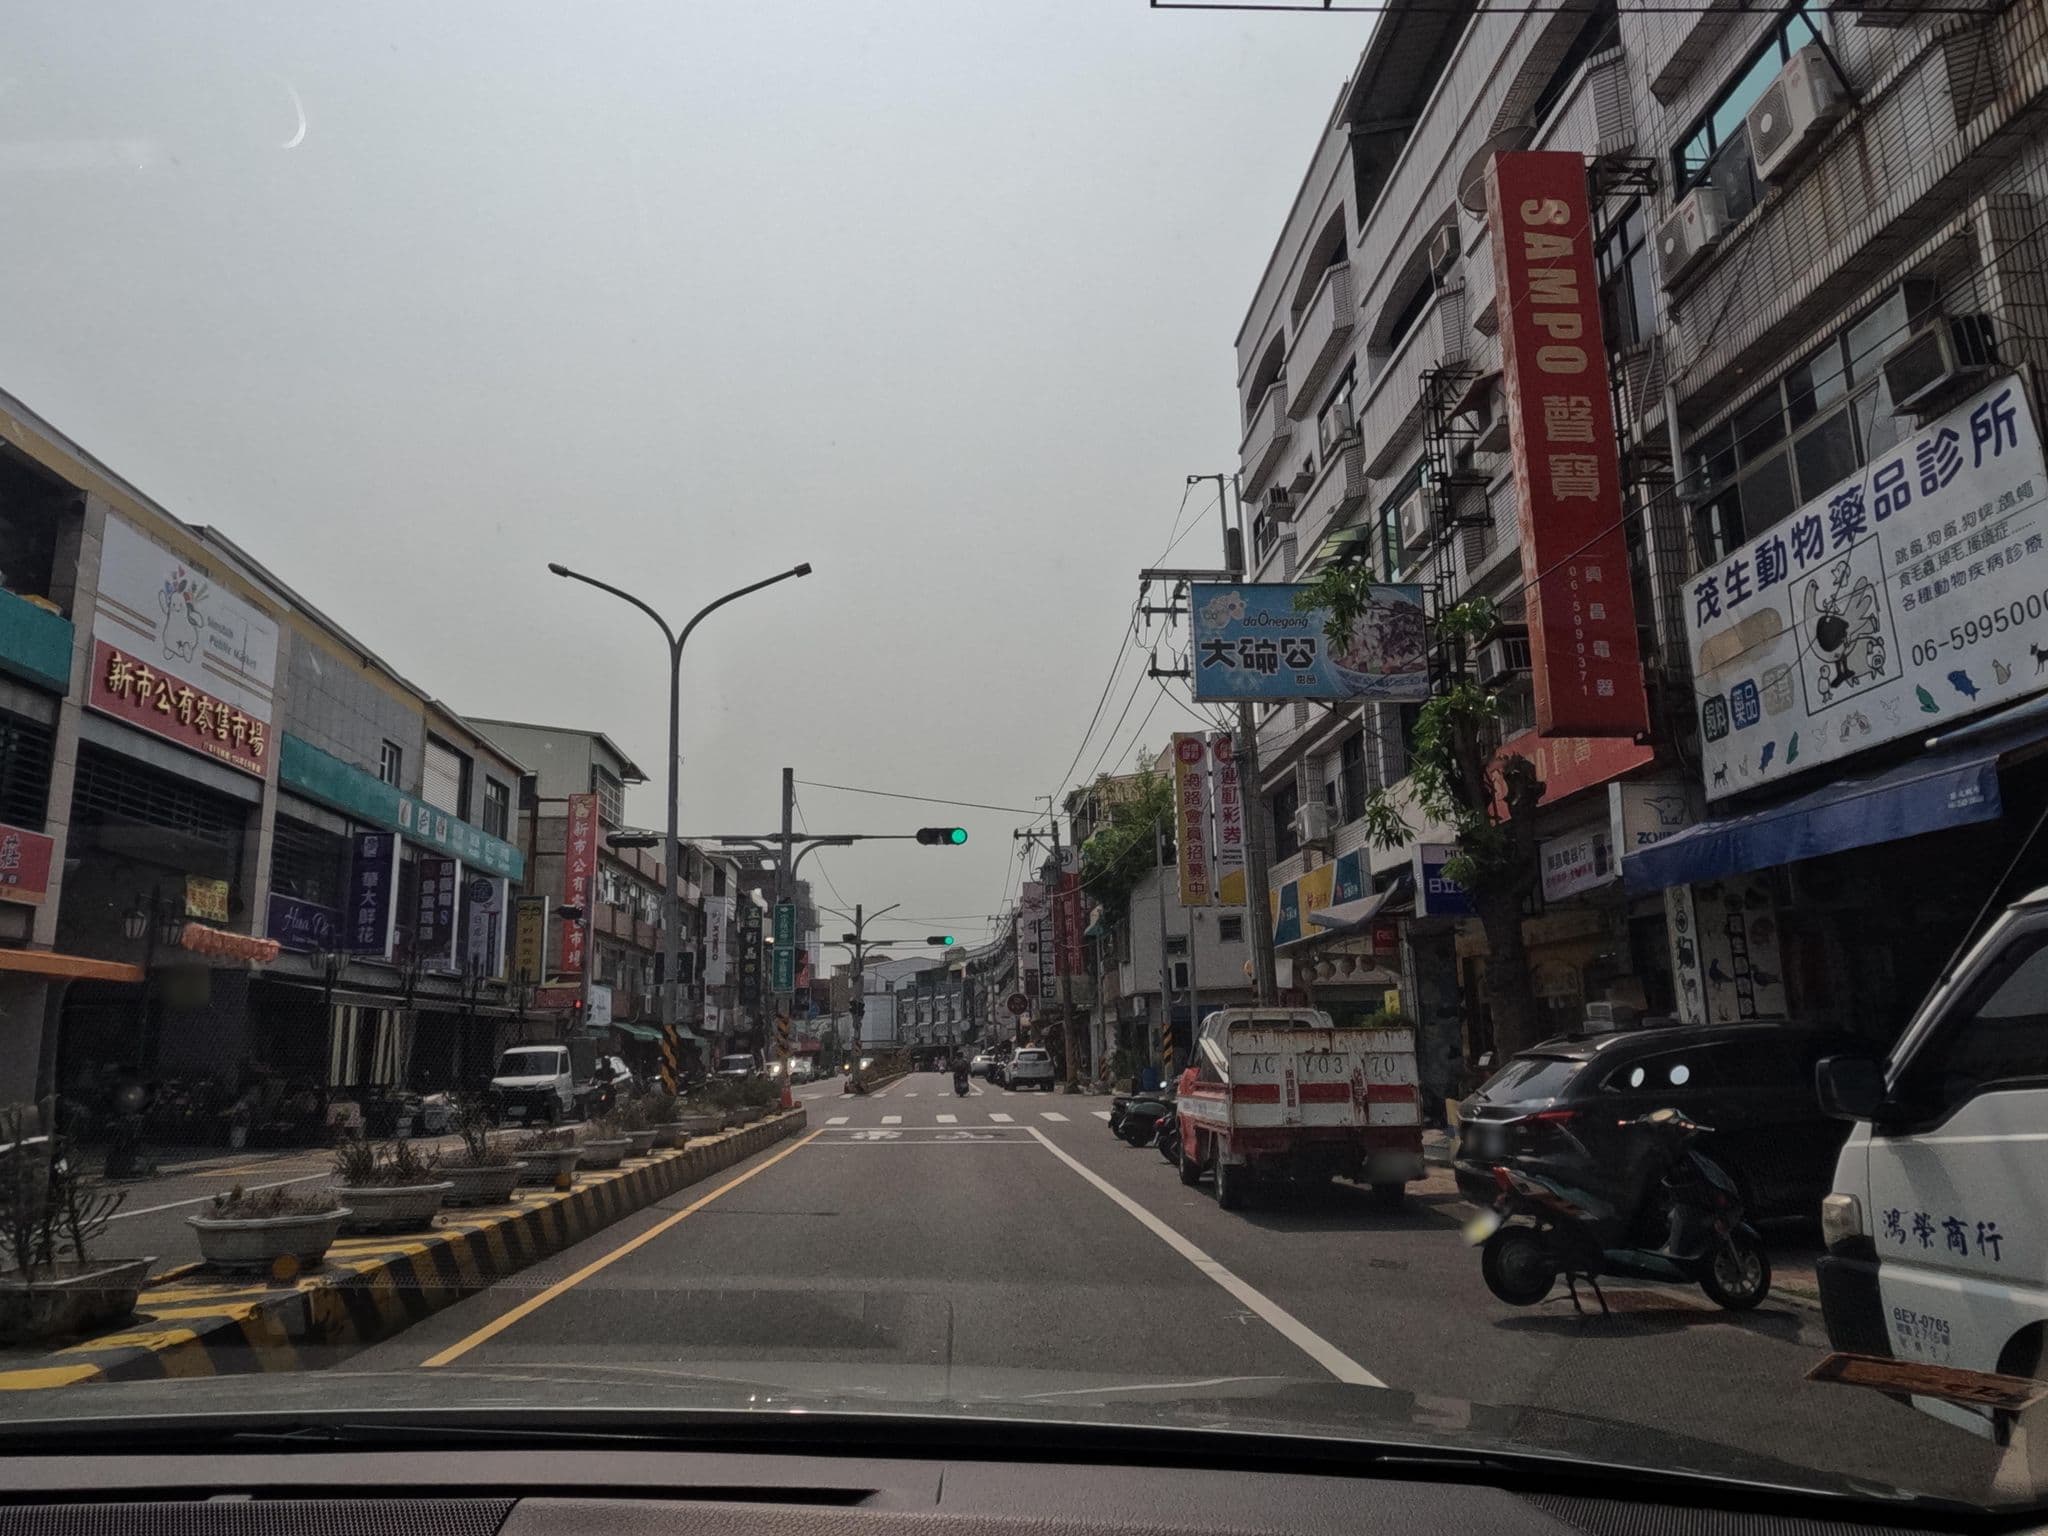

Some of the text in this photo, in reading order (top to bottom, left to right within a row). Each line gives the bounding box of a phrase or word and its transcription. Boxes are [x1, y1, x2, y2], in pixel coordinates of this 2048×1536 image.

[1519, 198, 1589, 375] SAMPO
[1542, 396, 1601, 503] 聲寶
[1694, 388, 2019, 628] 茂生動物藥品診所
[1902, 533, 2044, 611] 各種動物疾病診療
[1200, 637, 1317, 675] 大碗公
[108, 651, 265, 757] 新市公有零售市場
[1183, 773, 1206, 897] 網路會員招募中
[1221, 767, 1241, 844] 運動彩券
[357, 871, 380, 944] 華大鮮花
[1883, 1208, 2004, 1262] 鴻榮商行
